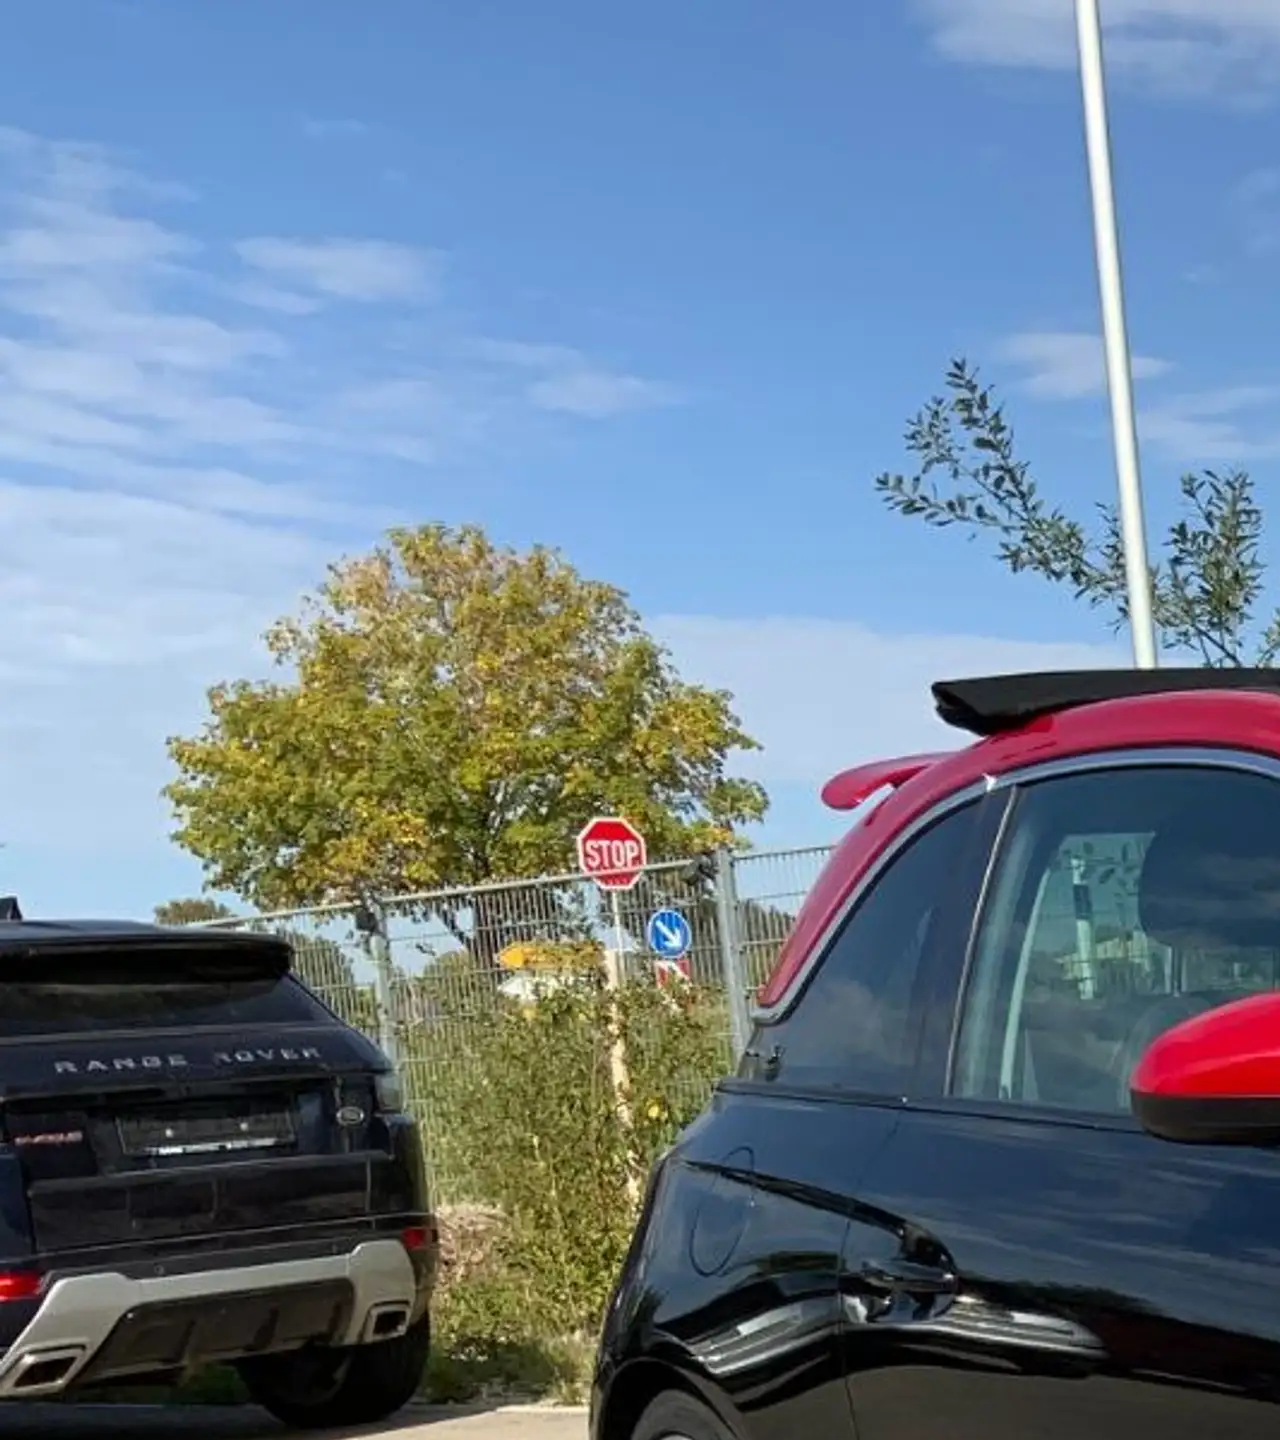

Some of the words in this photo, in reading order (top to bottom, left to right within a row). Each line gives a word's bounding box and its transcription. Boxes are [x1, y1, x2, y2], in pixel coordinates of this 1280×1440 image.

[585, 840, 639, 869] STOP
[54, 1053, 189, 1074] RANGE
[213, 1046, 321, 1066] ROVER
